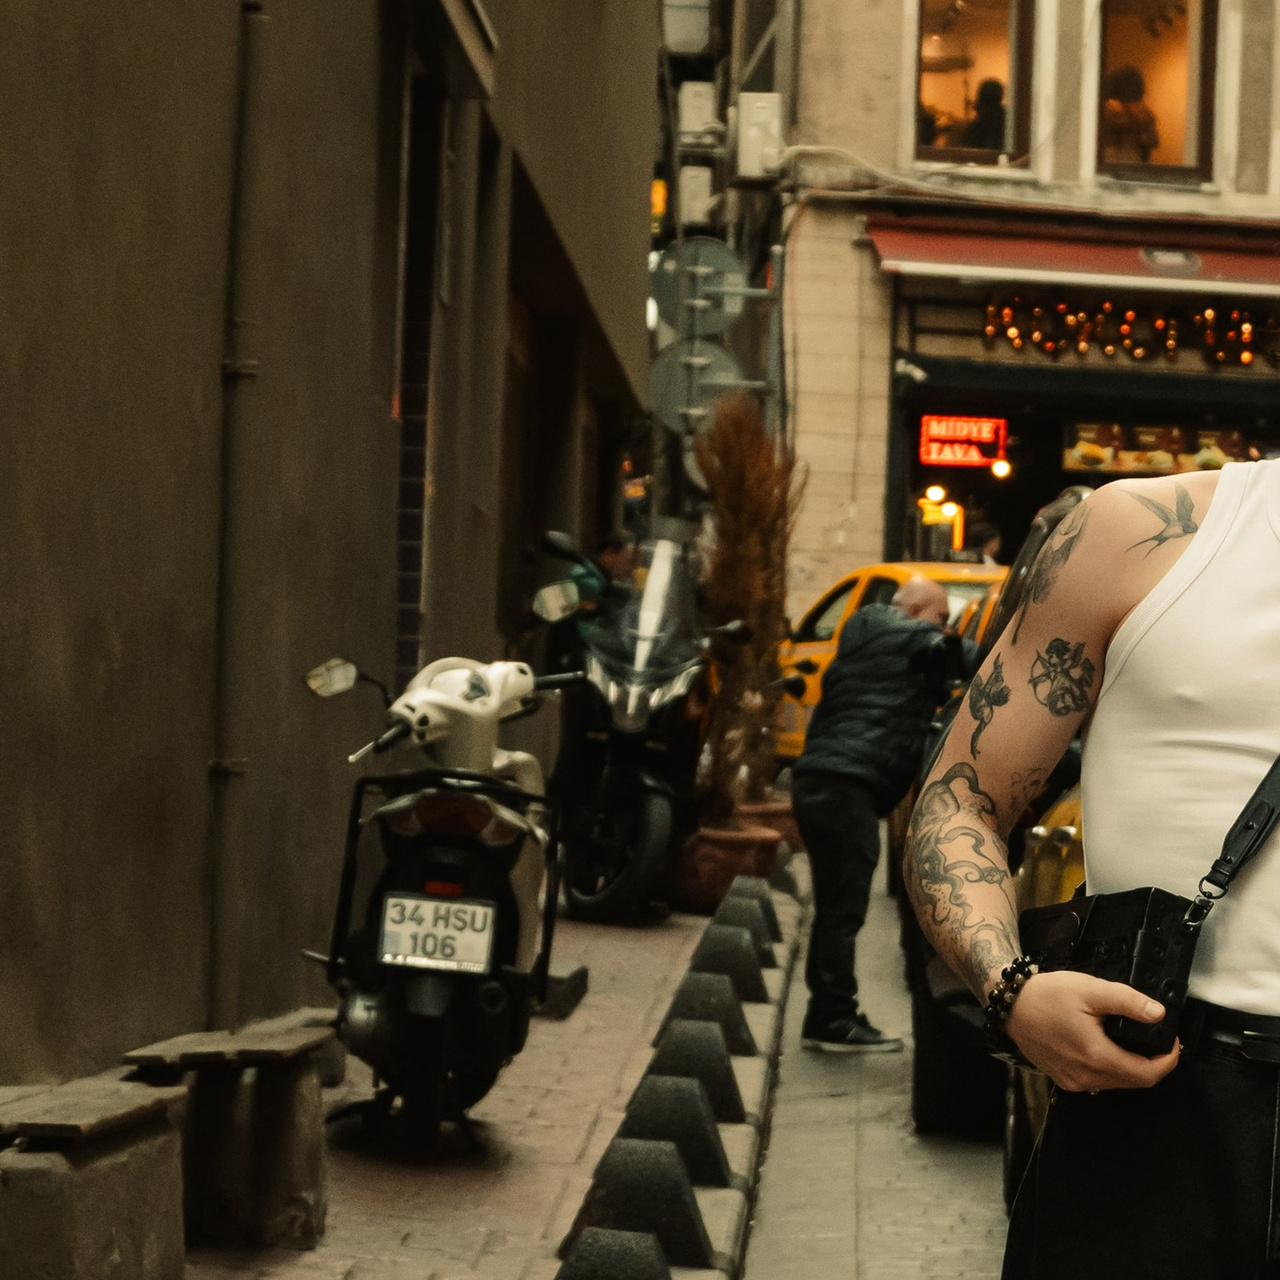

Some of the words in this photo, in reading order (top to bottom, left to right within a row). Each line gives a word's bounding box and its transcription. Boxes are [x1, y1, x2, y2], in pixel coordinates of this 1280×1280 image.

[390, 901, 426, 927] 34
[432, 904, 488, 932] HSU
[409, 930, 457, 958] 106
